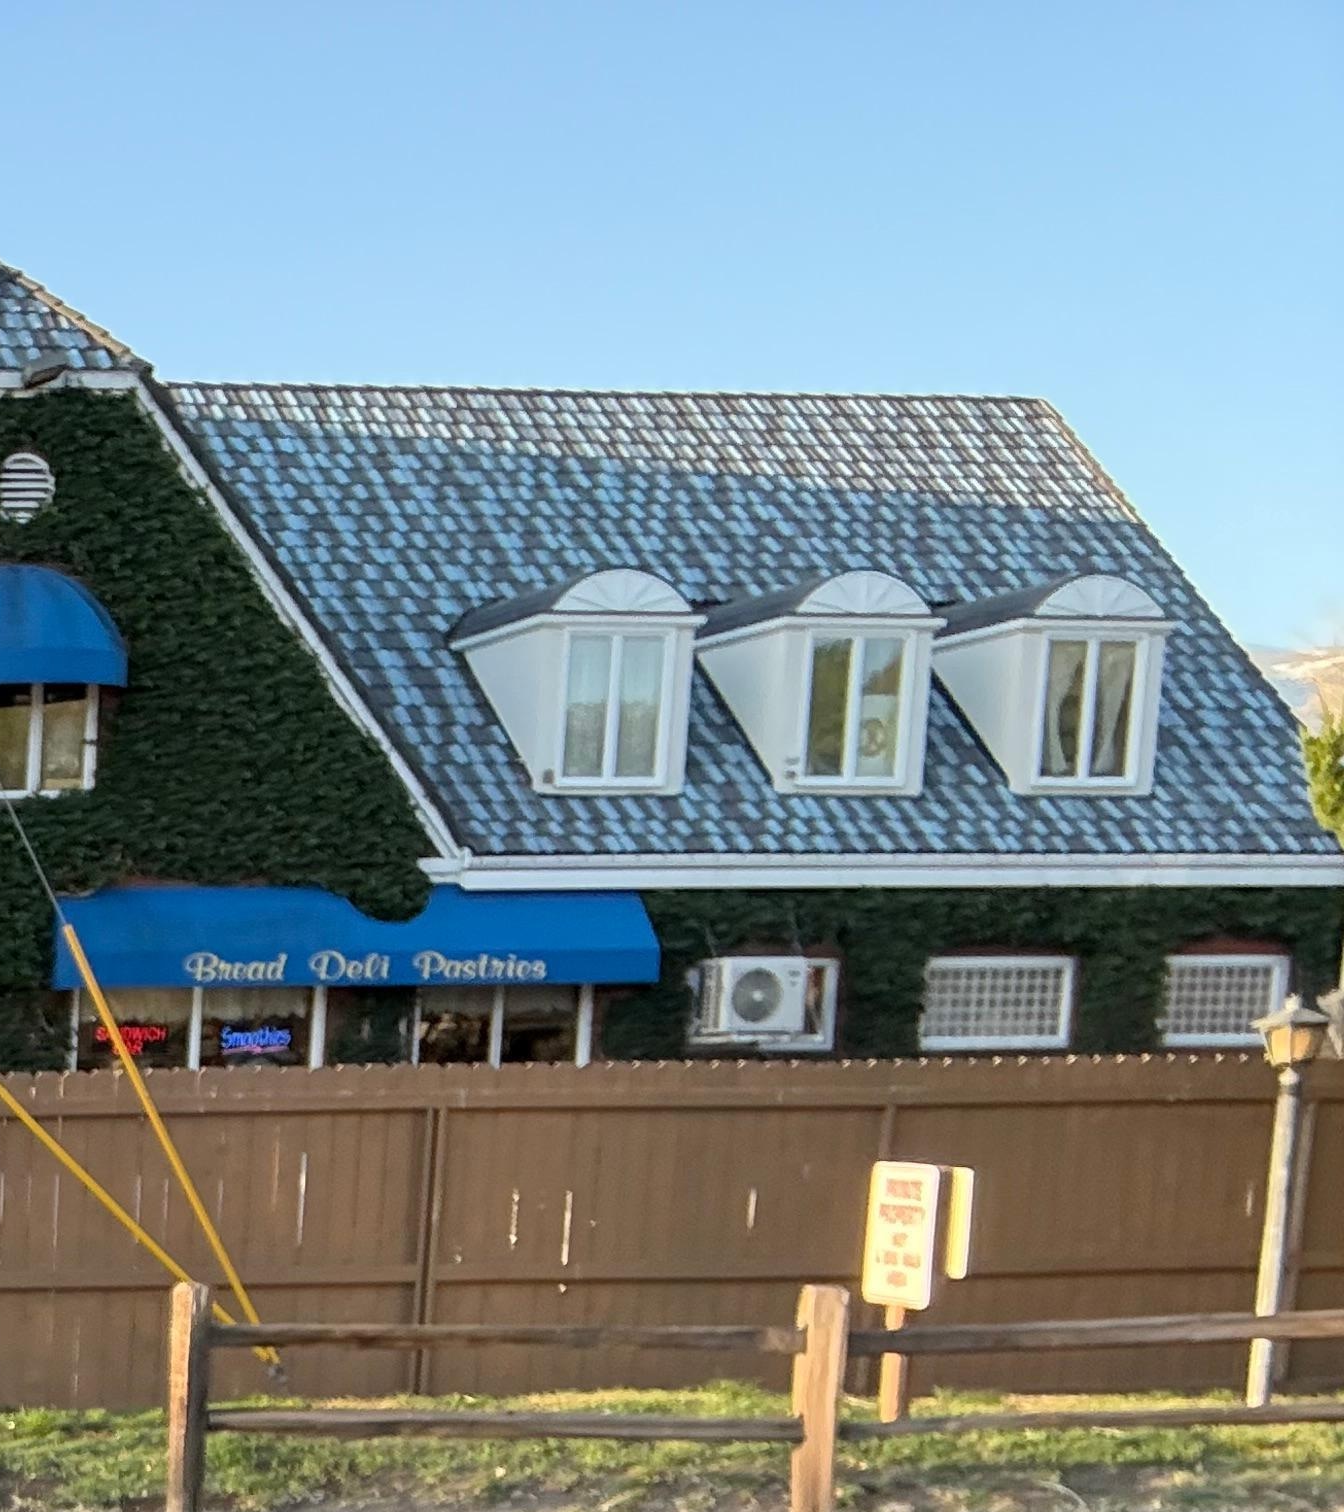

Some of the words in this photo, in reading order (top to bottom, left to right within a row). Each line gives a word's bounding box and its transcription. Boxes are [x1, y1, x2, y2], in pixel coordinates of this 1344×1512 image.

[184, 952, 288, 981] Bread
[309, 950, 390, 981] Deli
[413, 950, 547, 981] Pastries
